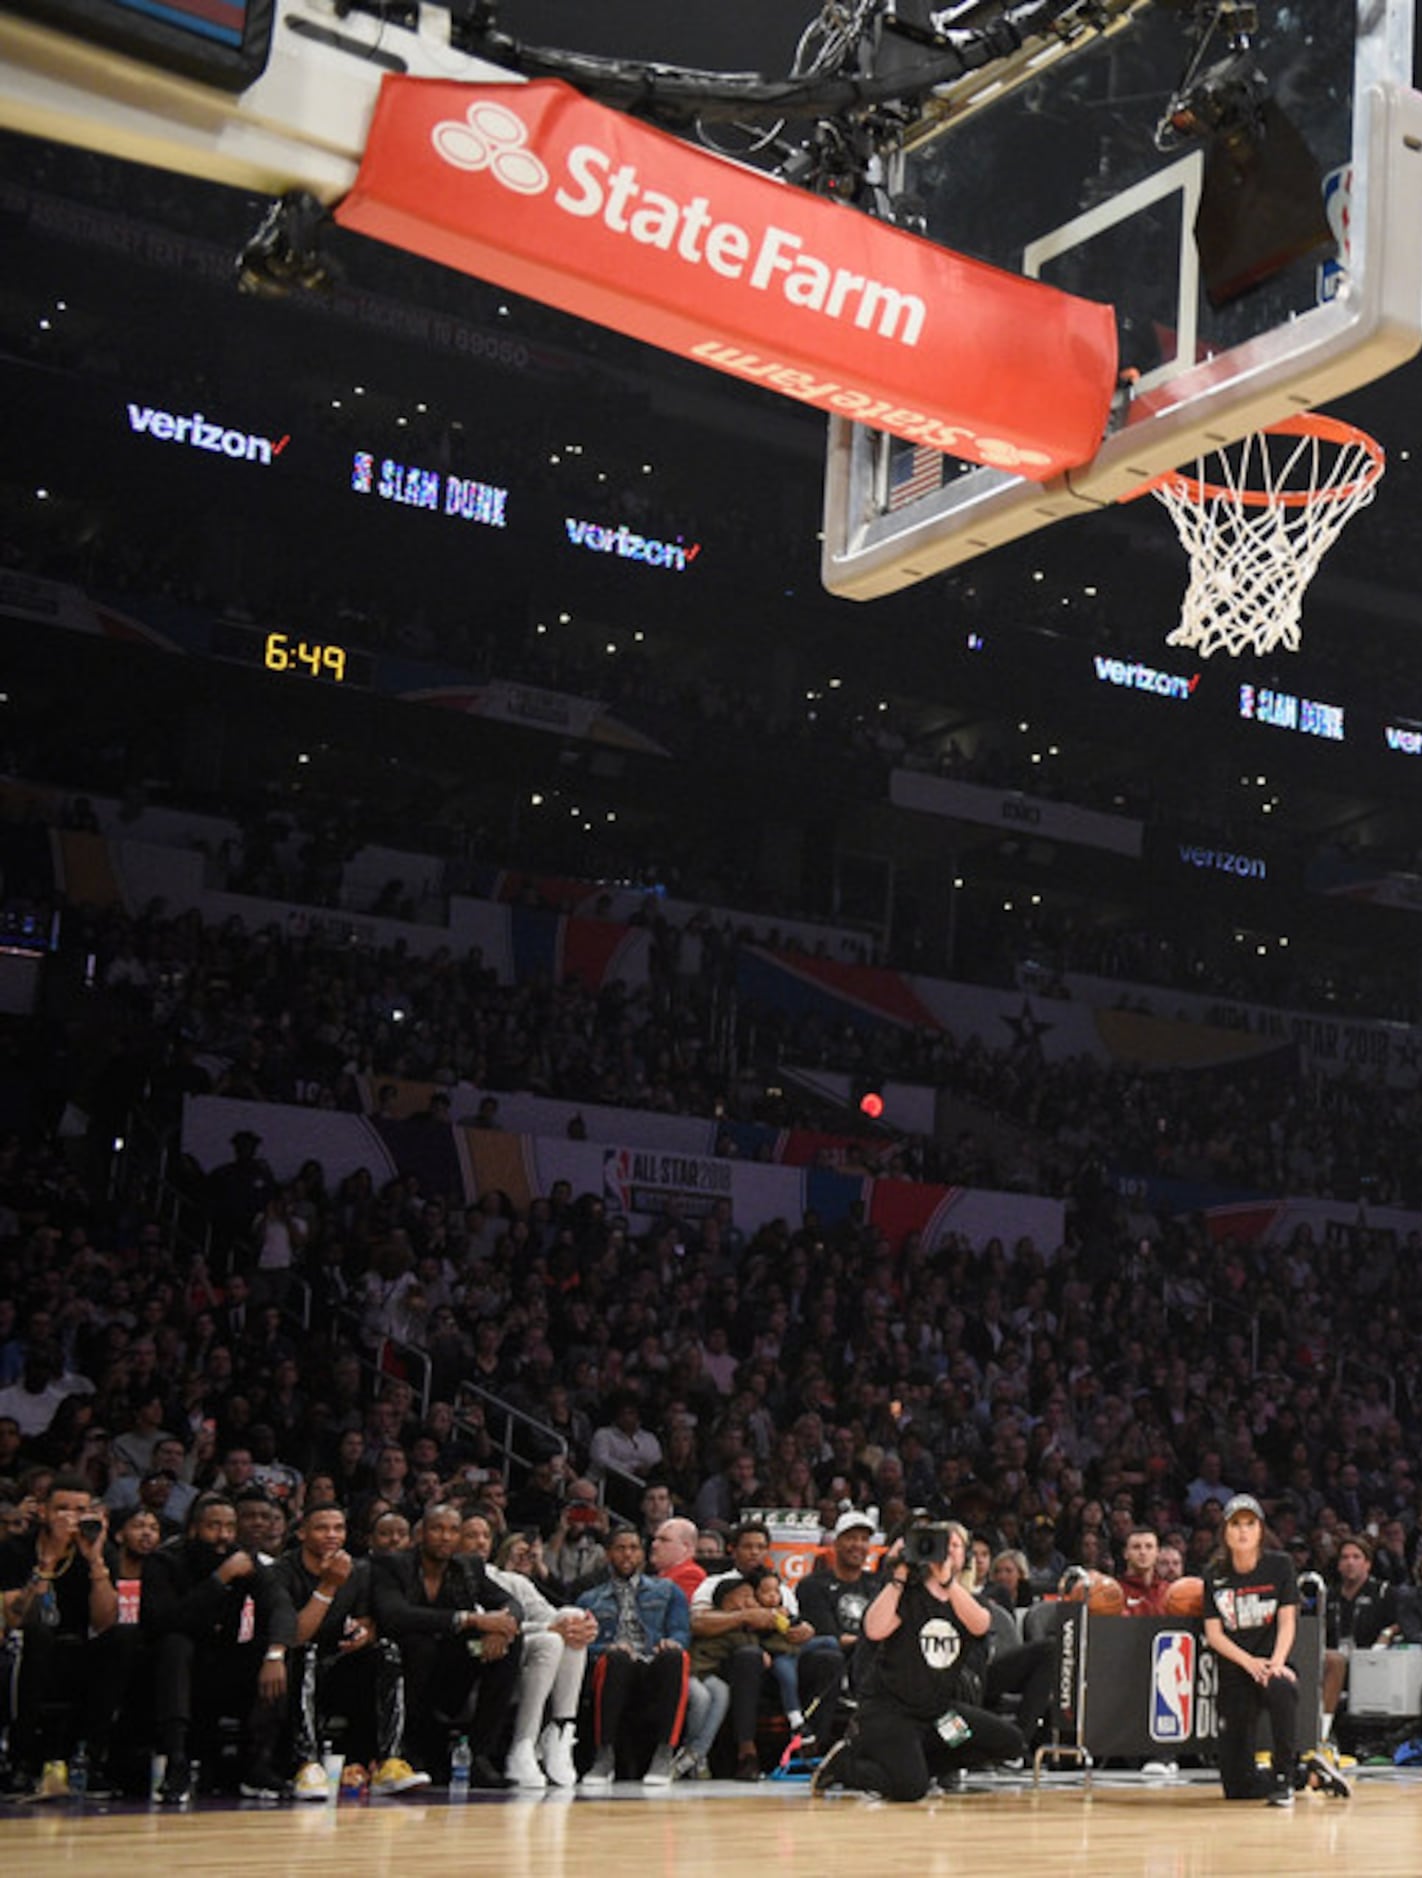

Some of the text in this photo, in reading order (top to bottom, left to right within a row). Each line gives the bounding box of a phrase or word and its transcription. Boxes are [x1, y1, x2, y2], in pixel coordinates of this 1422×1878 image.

[128, 404, 272, 466] verizon
[377, 459, 508, 528] SLAM DUNK
[565, 517, 687, 571] verizon
[265, 633, 347, 683] 6:49
[1094, 655, 1190, 699] verizon
[1256, 687, 1299, 730] SLAM
[1178, 842, 1267, 881] verizon
[785, 1555, 804, 1577] G
[919, 1634, 961, 1653] TNT
[1059, 1618, 1075, 1710] verizon
